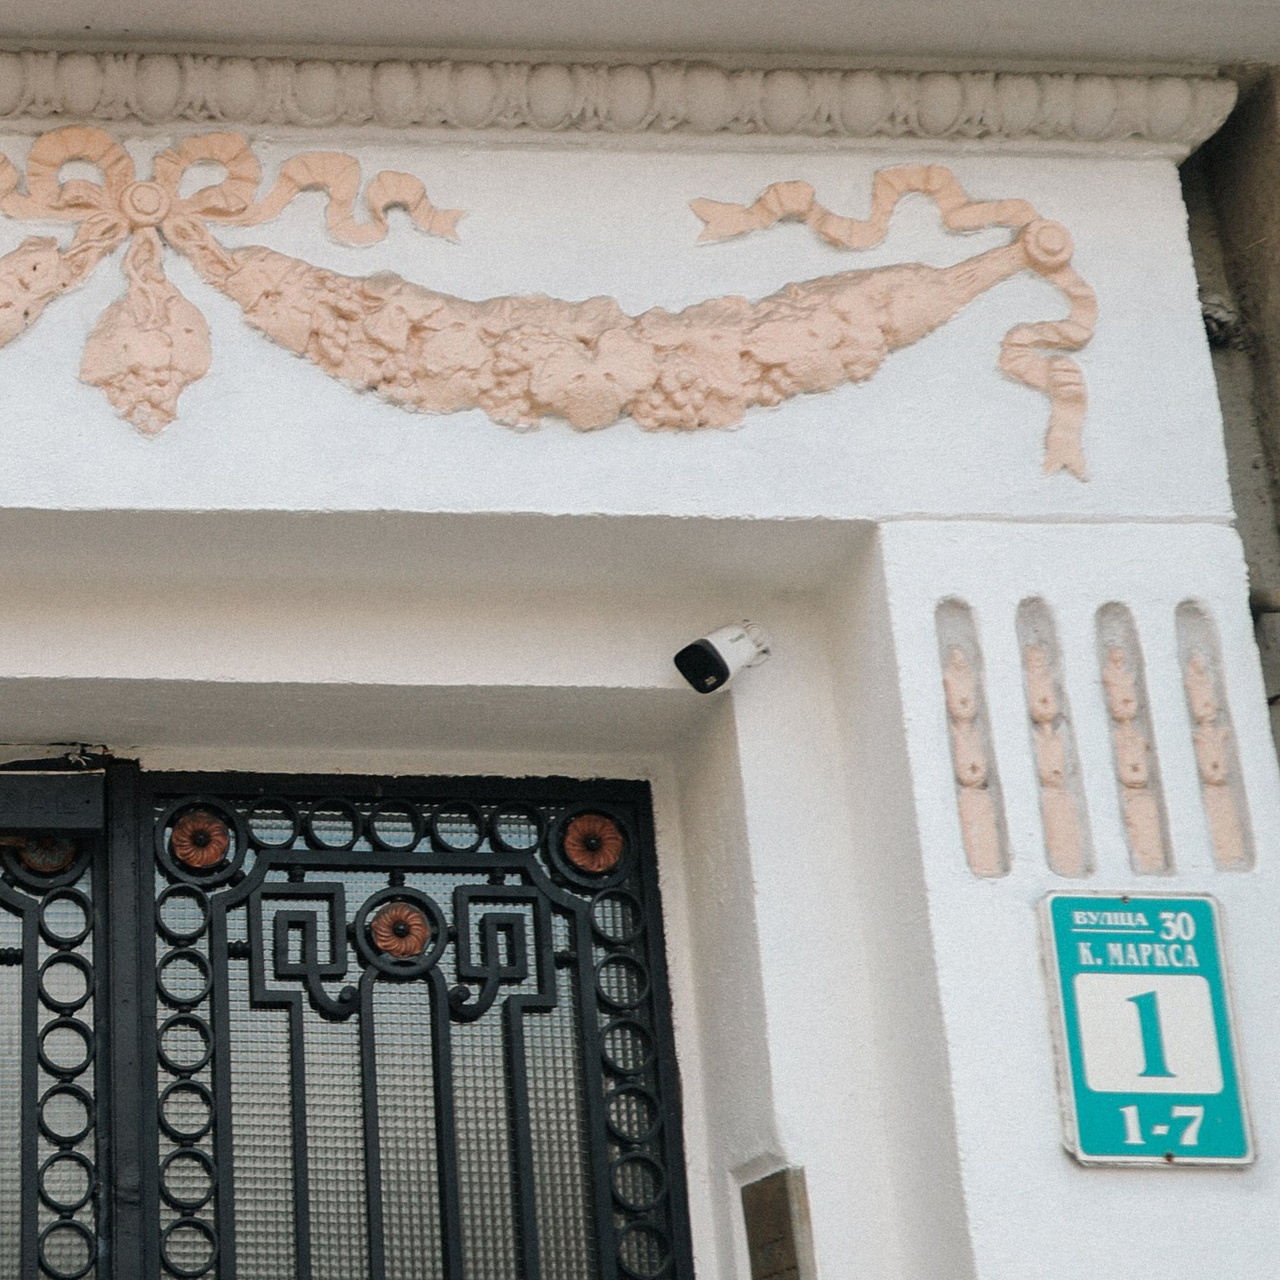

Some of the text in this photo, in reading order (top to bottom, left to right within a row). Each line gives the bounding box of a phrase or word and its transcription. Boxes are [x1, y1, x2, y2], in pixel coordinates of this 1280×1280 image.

[1071, 910, 1149, 927] ВУЛІЦА
[1160, 911, 1196, 940] 30
[1078, 942, 1200, 967] К. МАРКСА
[1125, 990, 1178, 1078] 1
[1119, 1105, 1205, 1146] 1-7
